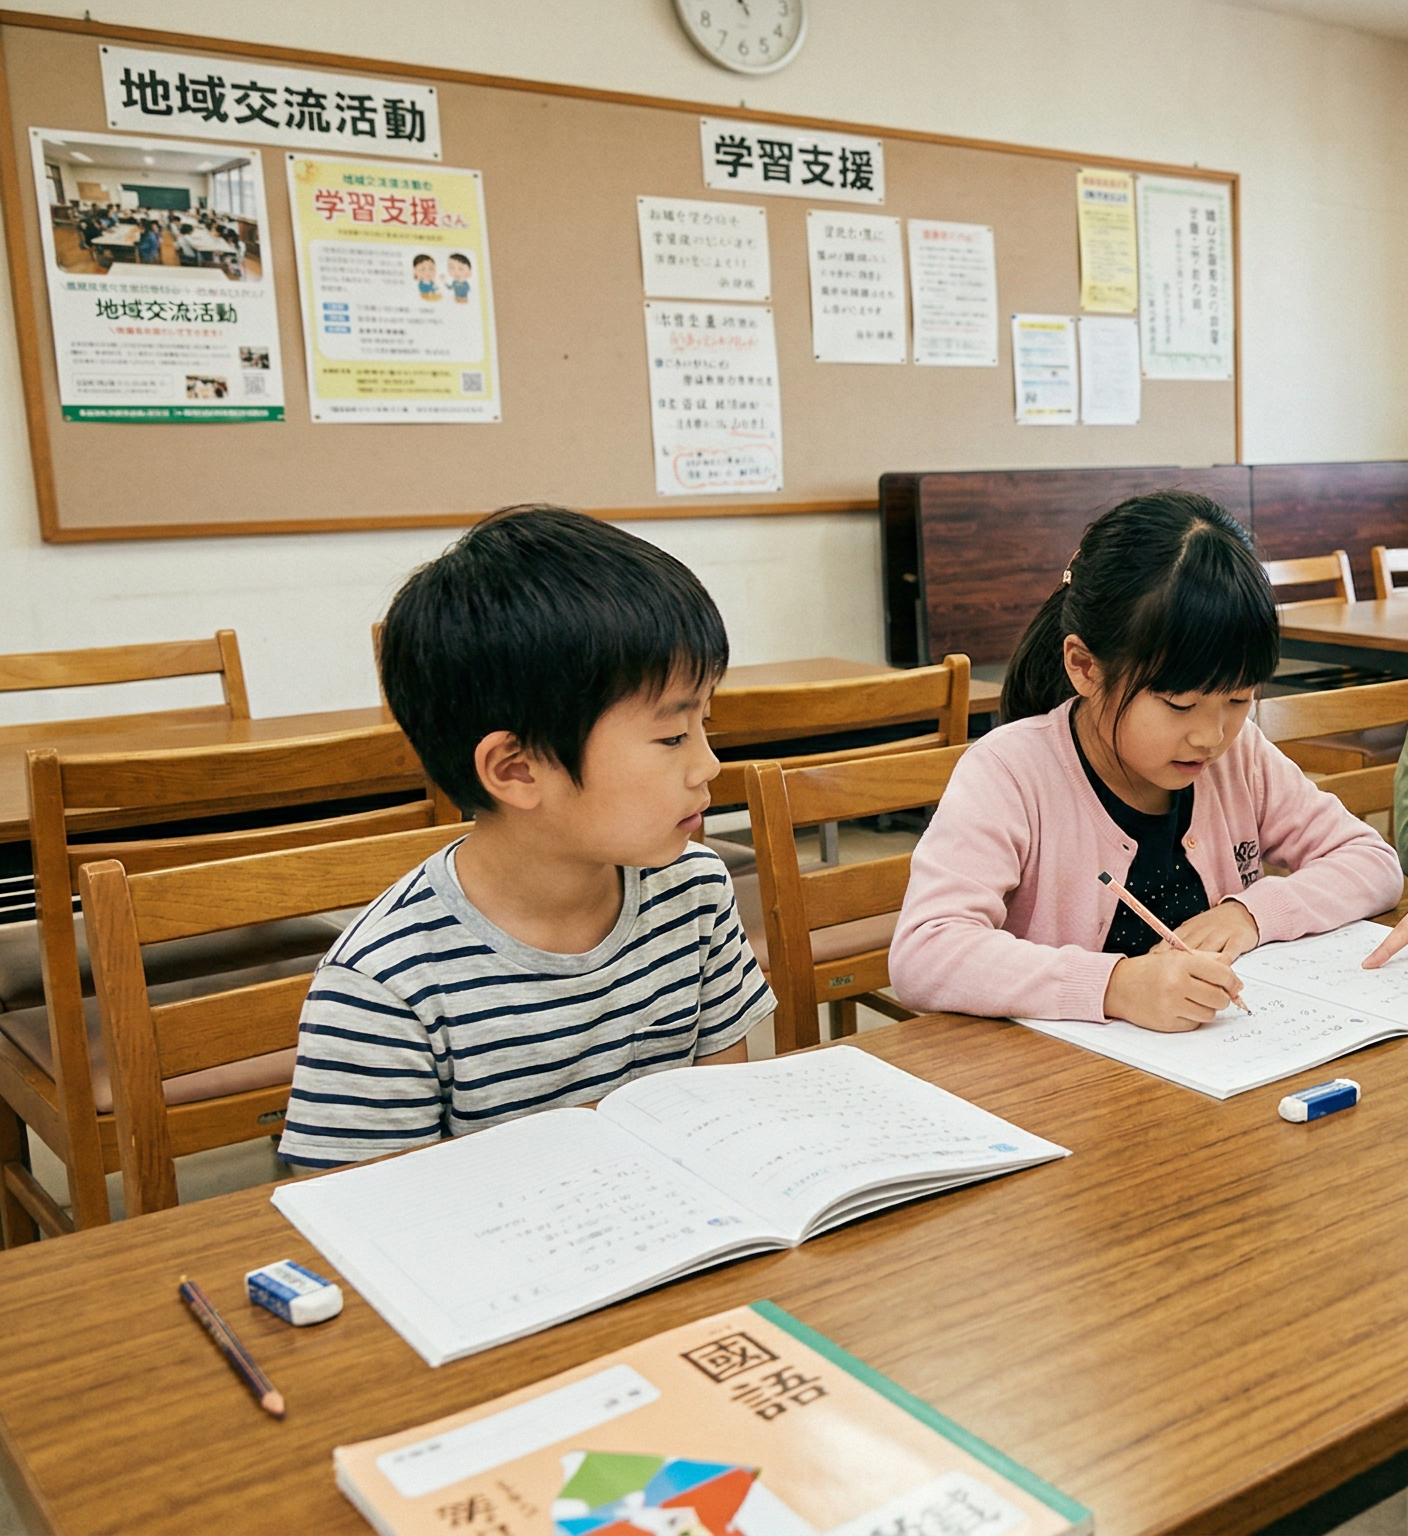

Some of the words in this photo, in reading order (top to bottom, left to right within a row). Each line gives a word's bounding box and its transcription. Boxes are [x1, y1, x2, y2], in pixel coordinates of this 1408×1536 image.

[701, 10, 711, 28] 8
[773, 23, 783, 38] 4
[738, 40, 749, 56] 6
[760, 37, 769, 54] 5
[119, 66, 427, 144] 地域交流活動
[714, 134, 875, 192] 学習支援
[95, 298, 238, 324] 地域交流活動
[679, 1331, 830, 1421] 國語
